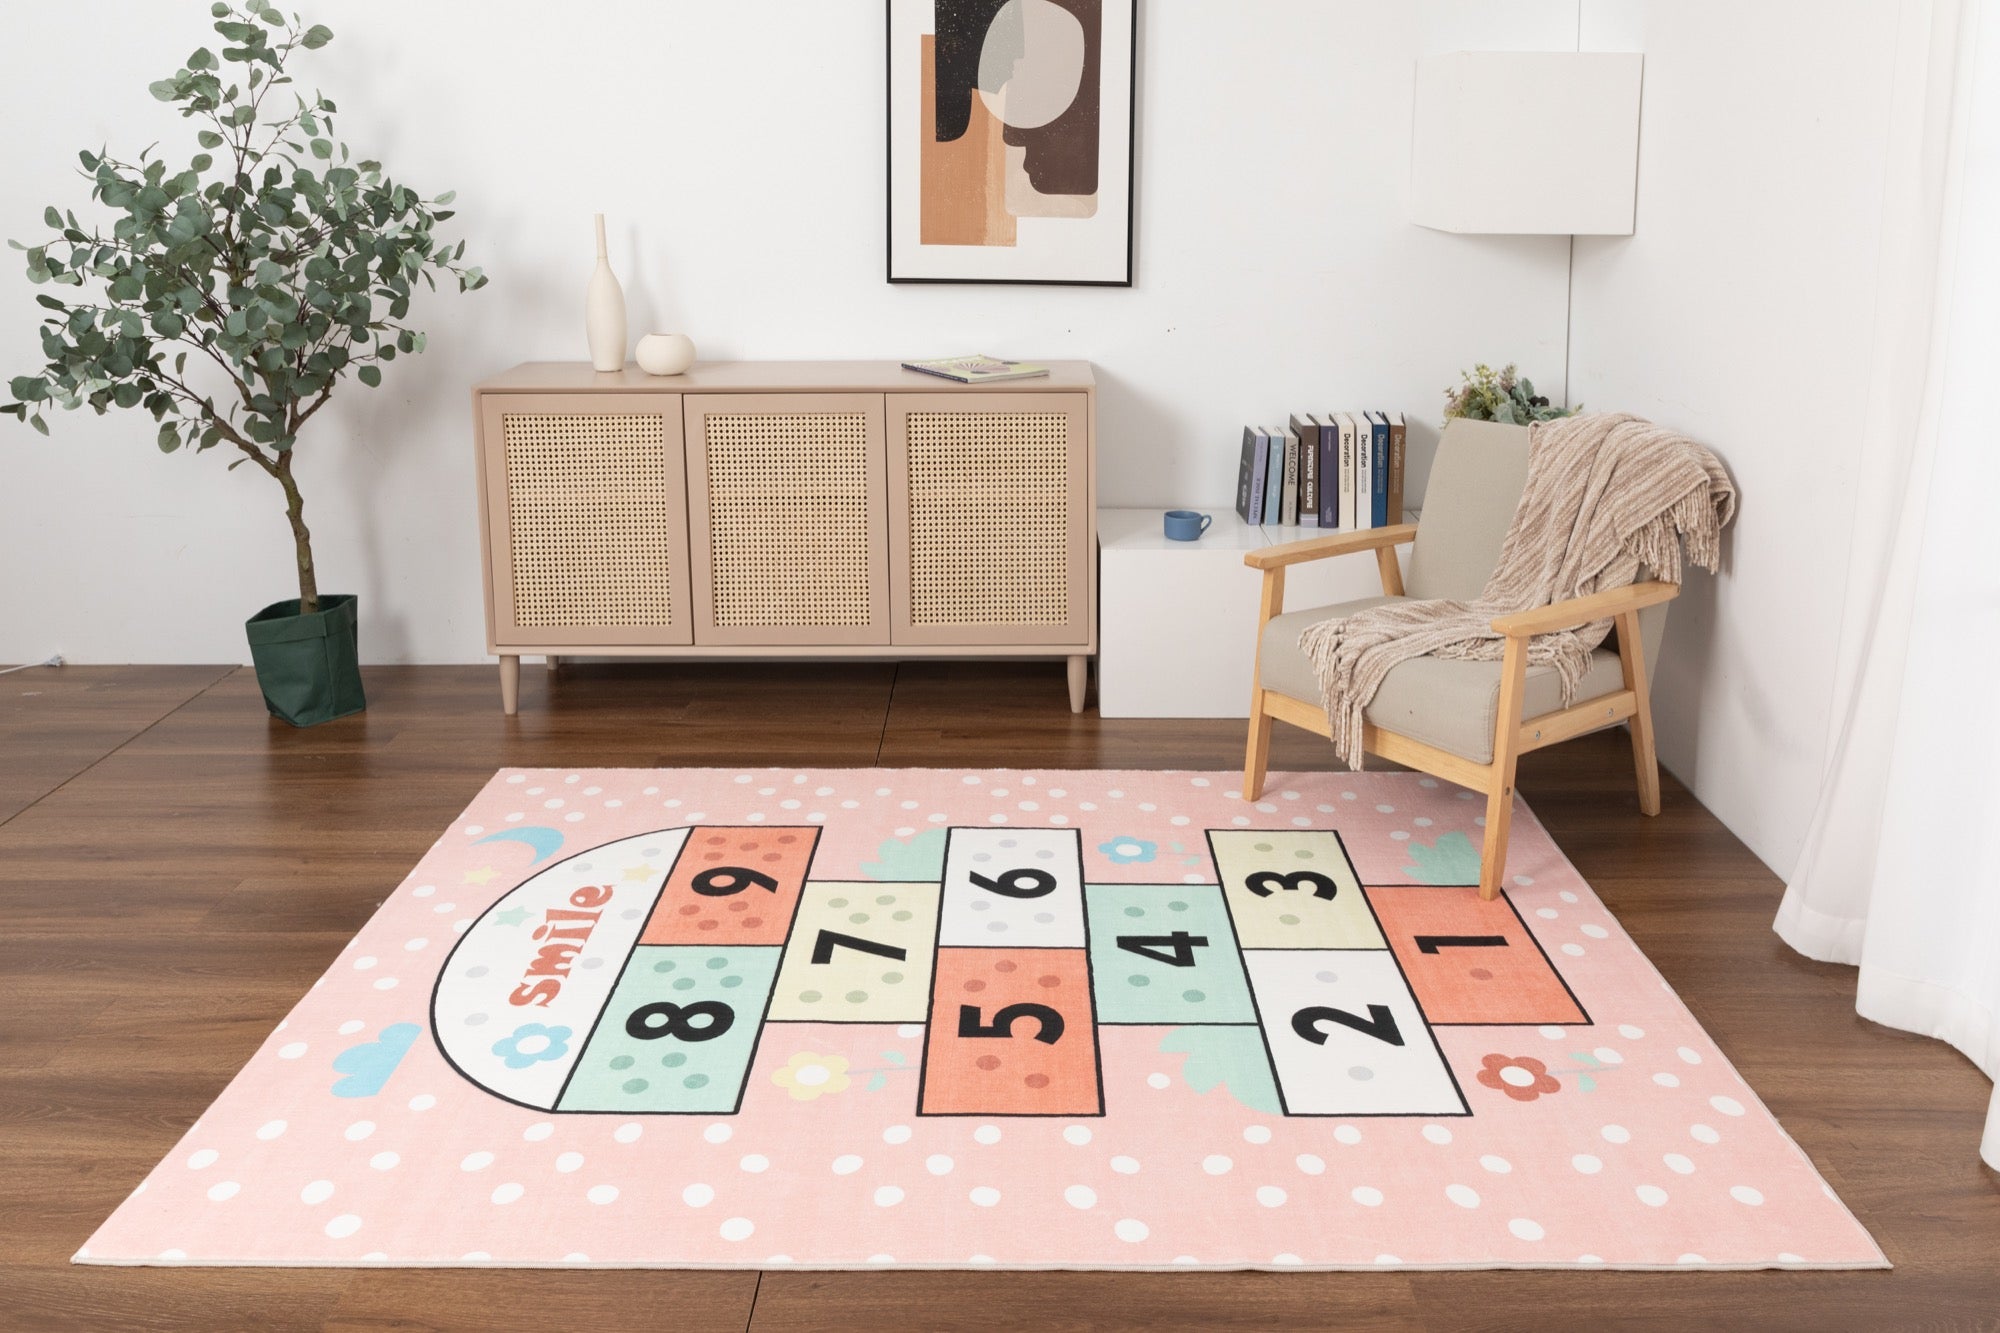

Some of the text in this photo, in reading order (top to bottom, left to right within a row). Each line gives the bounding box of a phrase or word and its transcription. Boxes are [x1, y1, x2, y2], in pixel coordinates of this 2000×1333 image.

[1288, 443, 1297, 487] WELCOME
[1343, 433, 1351, 468] Decoration
[1360, 433, 1368, 468] Decoration
[1377, 433, 1385, 468] Decoration
[1394, 433, 1402, 468] Decoration
[692, 867, 778, 896] 9
[970, 869, 1056, 898] 6
[1246, 872, 1337, 900] 3
[509, 884, 614, 1008] smile
[812, 930, 906, 964] 7
[1117, 932, 1208, 966] 4
[1414, 936, 1509, 954] 1
[626, 1001, 734, 1041] 8
[958, 1003, 1064, 1044] 5
[1292, 1005, 1404, 1045] 2
